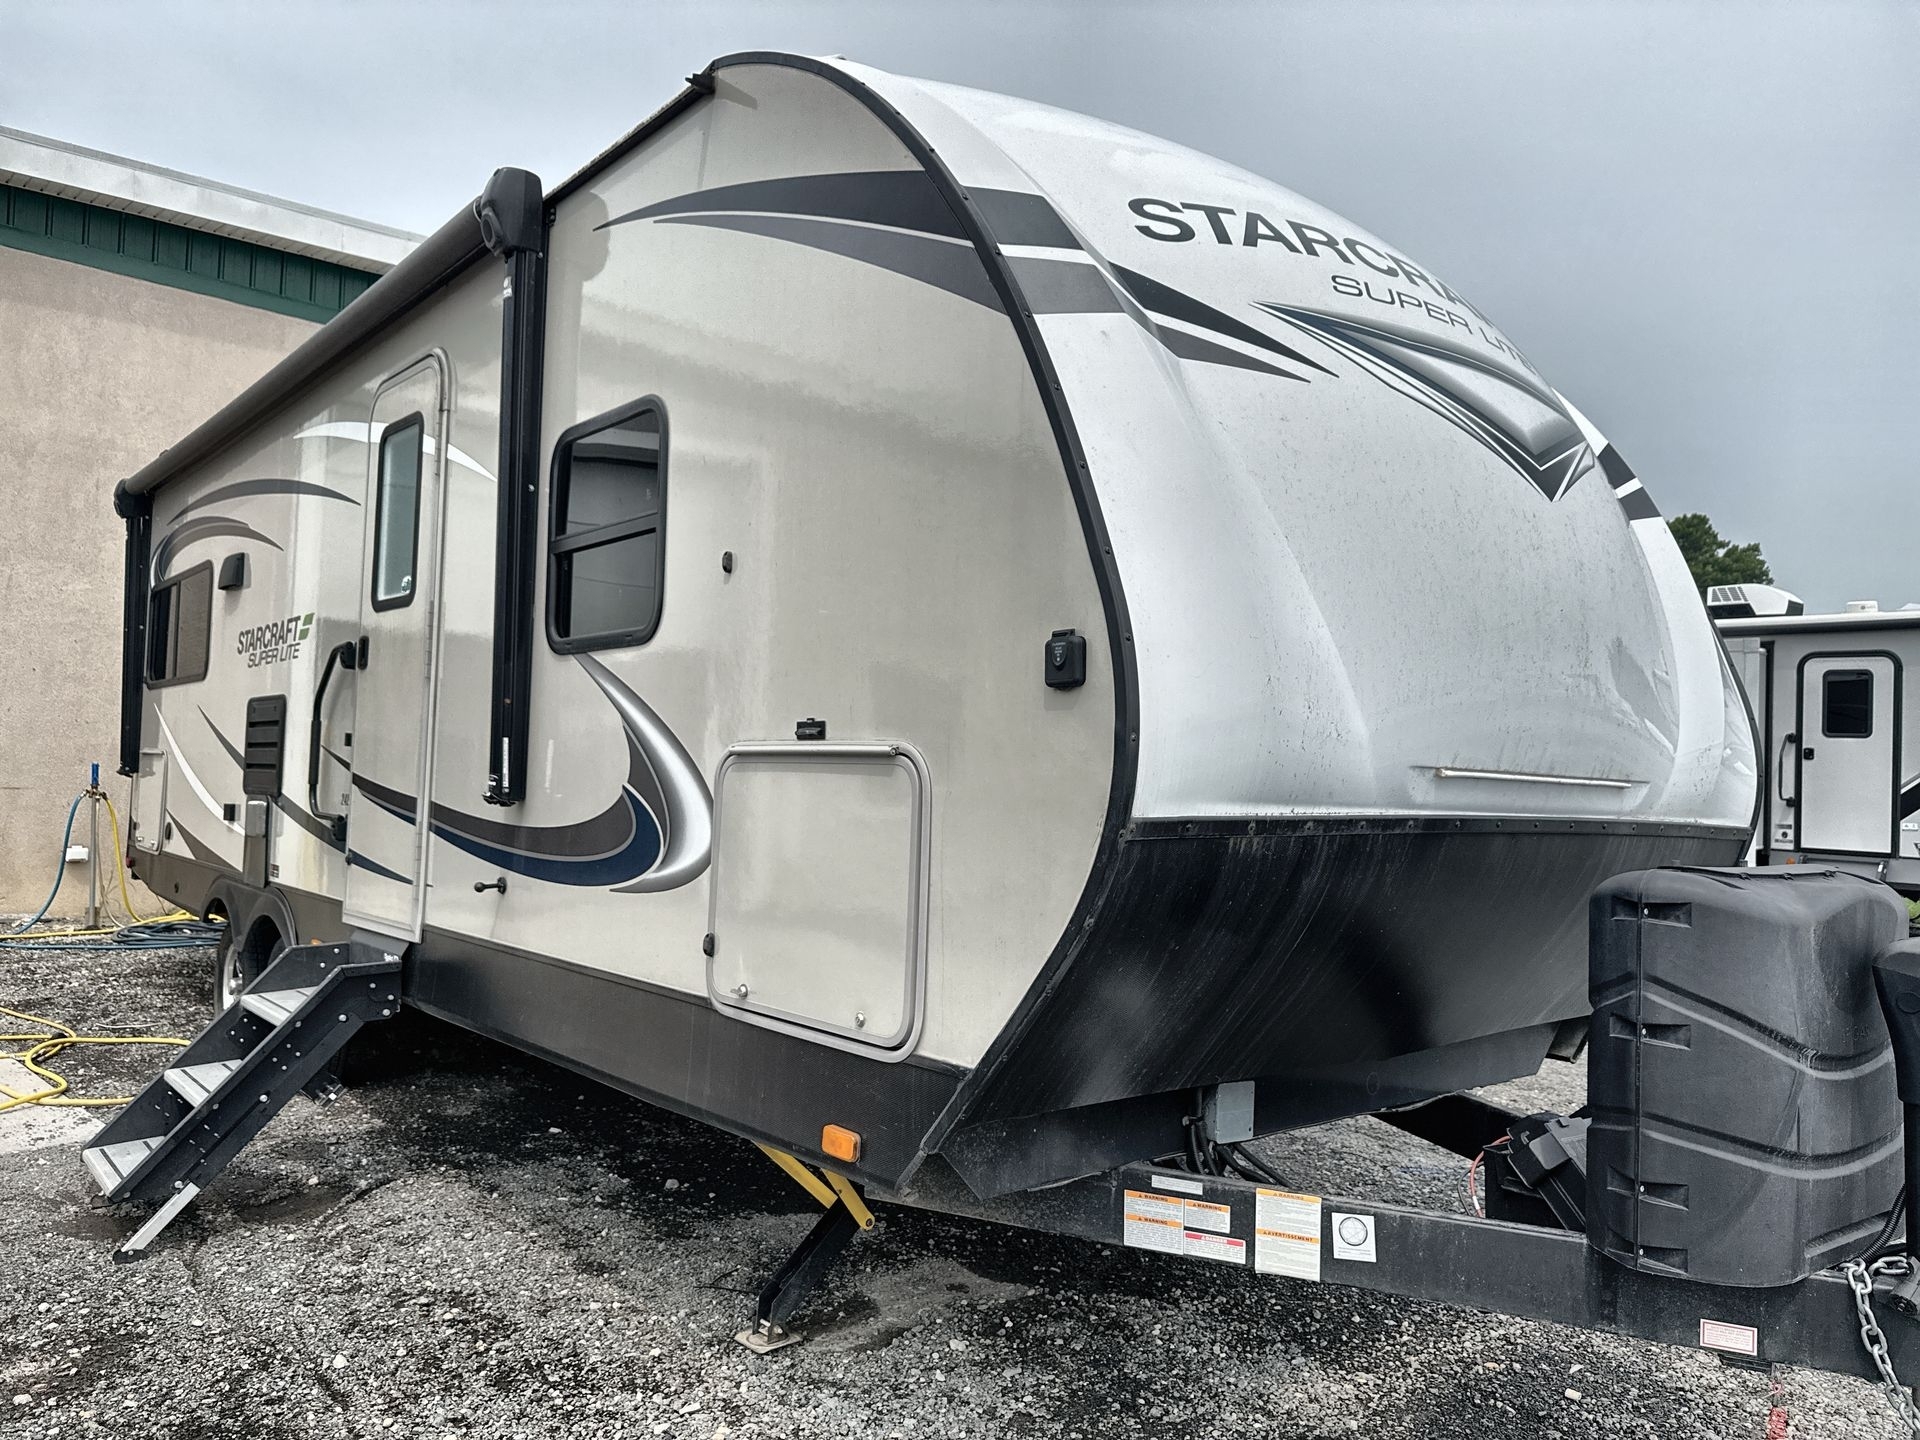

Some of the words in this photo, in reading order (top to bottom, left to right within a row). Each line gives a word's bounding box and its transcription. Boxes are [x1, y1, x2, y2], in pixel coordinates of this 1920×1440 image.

[1128, 198, 1487, 322] STARCRA
[1331, 274, 1473, 335] SUPER
[237, 615, 301, 656] STARCRAFT
[247, 647, 279, 669] SUPER
[279, 641, 301, 662] LITE
[1144, 1194, 1169, 1203] WARNING
[1197, 1202, 1222, 1212] WARNING
[1143, 1217, 1168, 1226] WARNING
